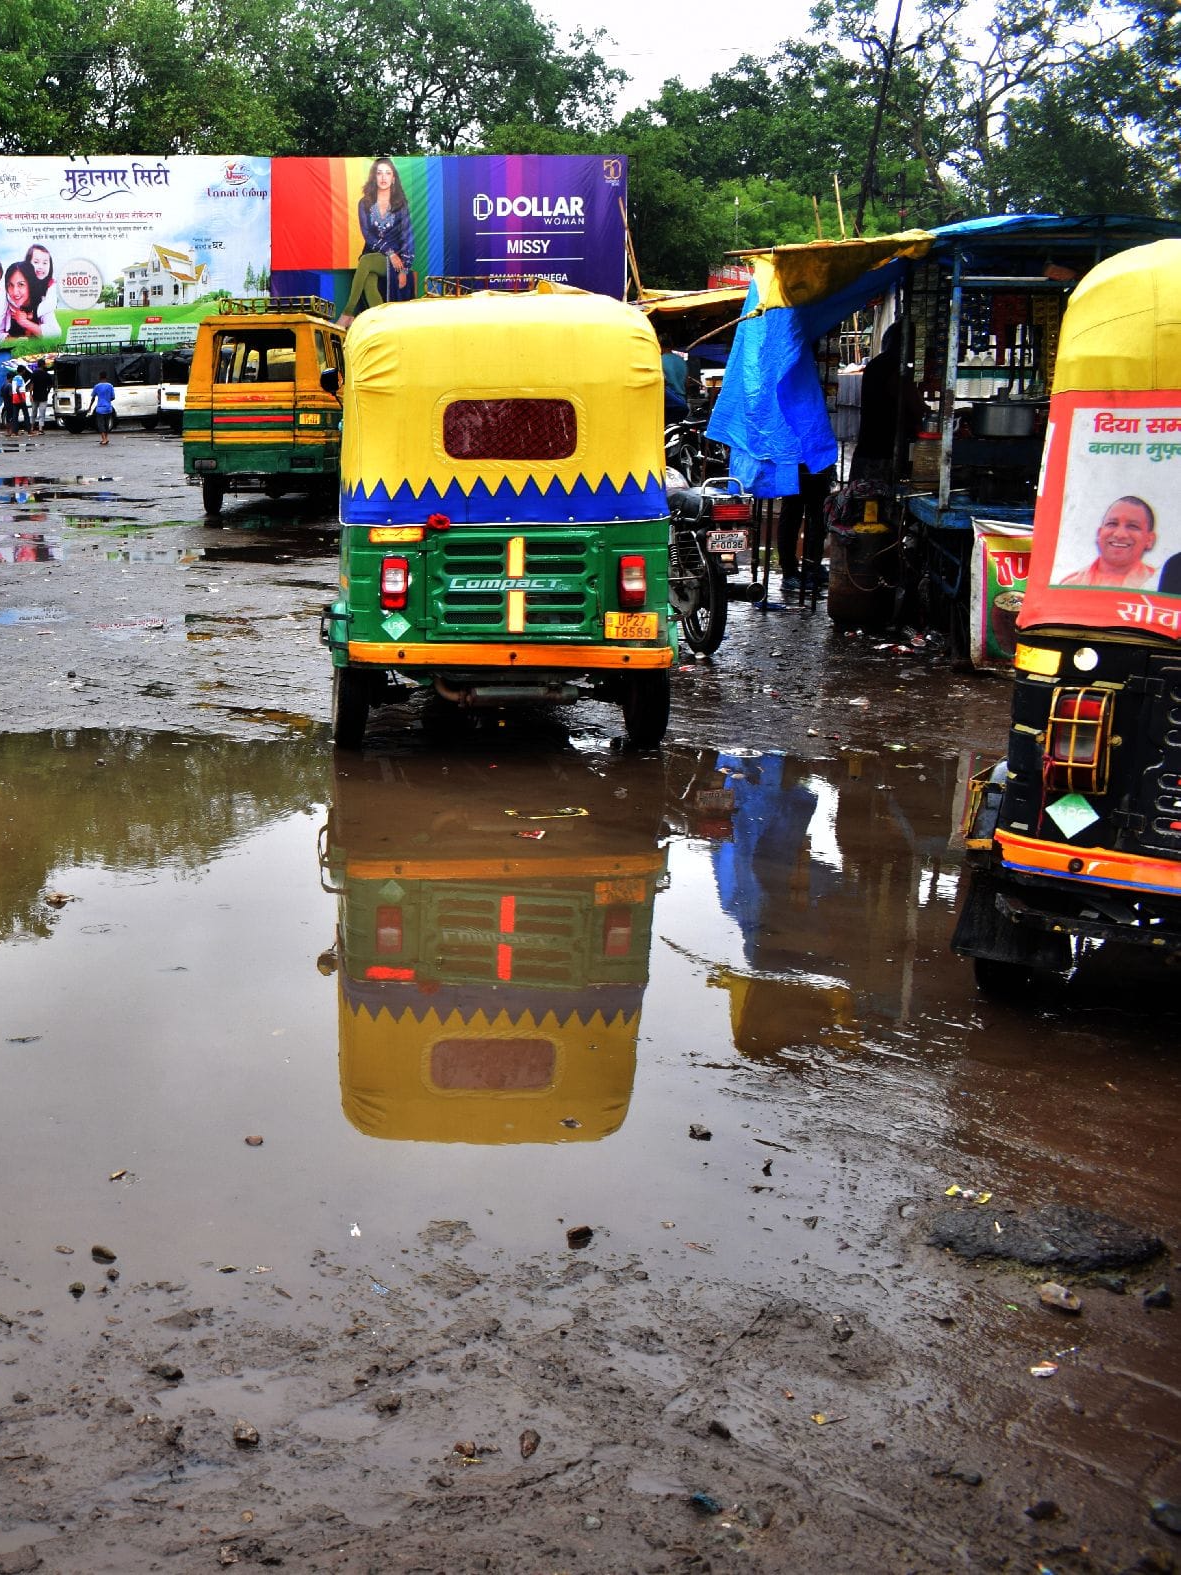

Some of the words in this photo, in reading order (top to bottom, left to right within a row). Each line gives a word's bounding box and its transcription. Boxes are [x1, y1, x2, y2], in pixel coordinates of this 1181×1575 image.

[132, 163, 170, 187] सिटी
[497, 196, 584, 217] DOLLAR
[543, 217, 585, 226] WOMAN
[507, 240, 551, 254] MISSY
[1093, 412, 1141, 434] दिया
[1146, 417, 1181, 434] सम्
[1088, 441, 1143, 456] बनाया
[1117, 595, 1180, 630] सोच
[387, 621, 405, 630] LPG
